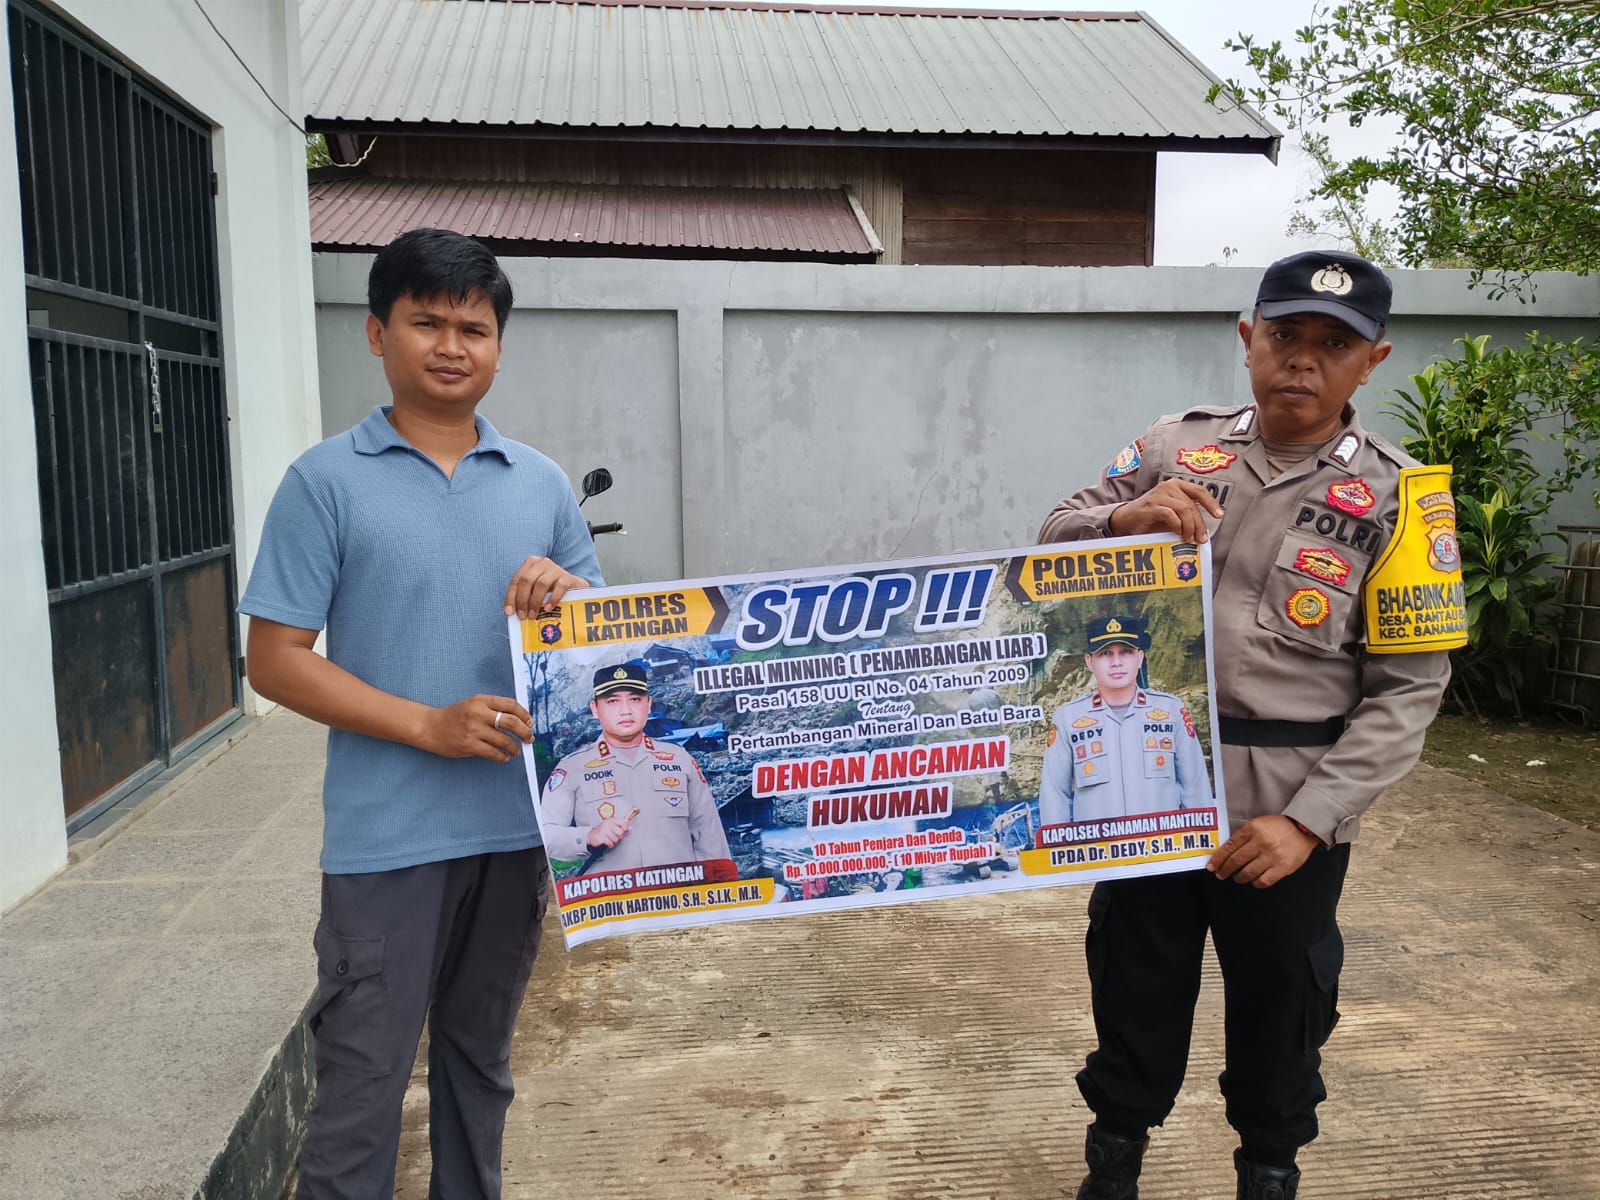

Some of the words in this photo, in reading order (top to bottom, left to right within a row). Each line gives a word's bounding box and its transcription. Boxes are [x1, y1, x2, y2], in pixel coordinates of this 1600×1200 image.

[1295, 505, 1380, 552] POLRI
[1033, 548, 1156, 581] POLSEK
[1035, 576, 1095, 596] SANAMAN
[1099, 572, 1157, 590] MANTIKEI
[584, 593, 686, 623] POLRES
[740, 576, 913, 646] STOP
[919, 567, 994, 627] !!!
[1378, 614, 1412, 626] DESA
[586, 617, 688, 642] KATINGAN
[1379, 626, 1410, 639] KEC.
[696, 665, 764, 692] ILLEGAL
[767, 655, 846, 684] MINNING
[861, 641, 992, 674] PENAMBANGAN
[995, 636, 1035, 660] LIAR
[738, 692, 785, 711] Pasal
[790, 689, 819, 705] 158
[824, 686, 849, 701] UU
[854, 683, 871, 698] RI
[876, 682, 904, 696] No.
[908, 678, 928, 692] 04
[933, 673, 983, 689] Tahun
[988, 667, 1026, 684] 2009
[860, 702, 913, 717] Tentang
[731, 728, 852, 751] Pertambangan
[858, 717, 918, 737] Mineral
[923, 715, 955, 730] Dan
[960, 711, 998, 726] Batu
[1003, 706, 1041, 721] Bara
[1071, 727, 1104, 743] DEDY
[1143, 724, 1174, 733] POLRI
[584, 770, 615, 782] DODIK
[653, 764, 682, 773] POLRI
[757, 755, 866, 794] DENGAN
[871, 740, 1006, 782] ANCAMAN
[811, 786, 949, 827] HUKUMAN
[1042, 824, 1100, 844] KAPOLSEK
[1102, 818, 1158, 838] SANAMAN
[1159, 811, 1214, 831] MANTIKEI
[814, 843, 827, 857] 10
[828, 840, 861, 856] Tahun
[863, 836, 904, 853] Penjara
[906, 833, 927, 847] Dan
[929, 831, 963, 845] Denda
[1051, 847, 1085, 865] IPDA
[1089, 846, 1108, 861] Dr.
[1110, 841, 1149, 859] DEDY,
[1151, 838, 1181, 853] S.H.,
[1183, 833, 1214, 849] M.H.
[786, 864, 804, 880] Rp.
[900, 852, 912, 866] 10
[914, 849, 948, 866] Milyar
[950, 845, 987, 862] Rupiah
[563, 873, 633, 900] KAPOLRES
[635, 865, 704, 888] KATINGAN
[589, 900, 624, 920] DODIK
[626, 894, 681, 914] HARTONO,
[683, 891, 706, 908] S.H.,
[738, 885, 762, 901] M.H.
